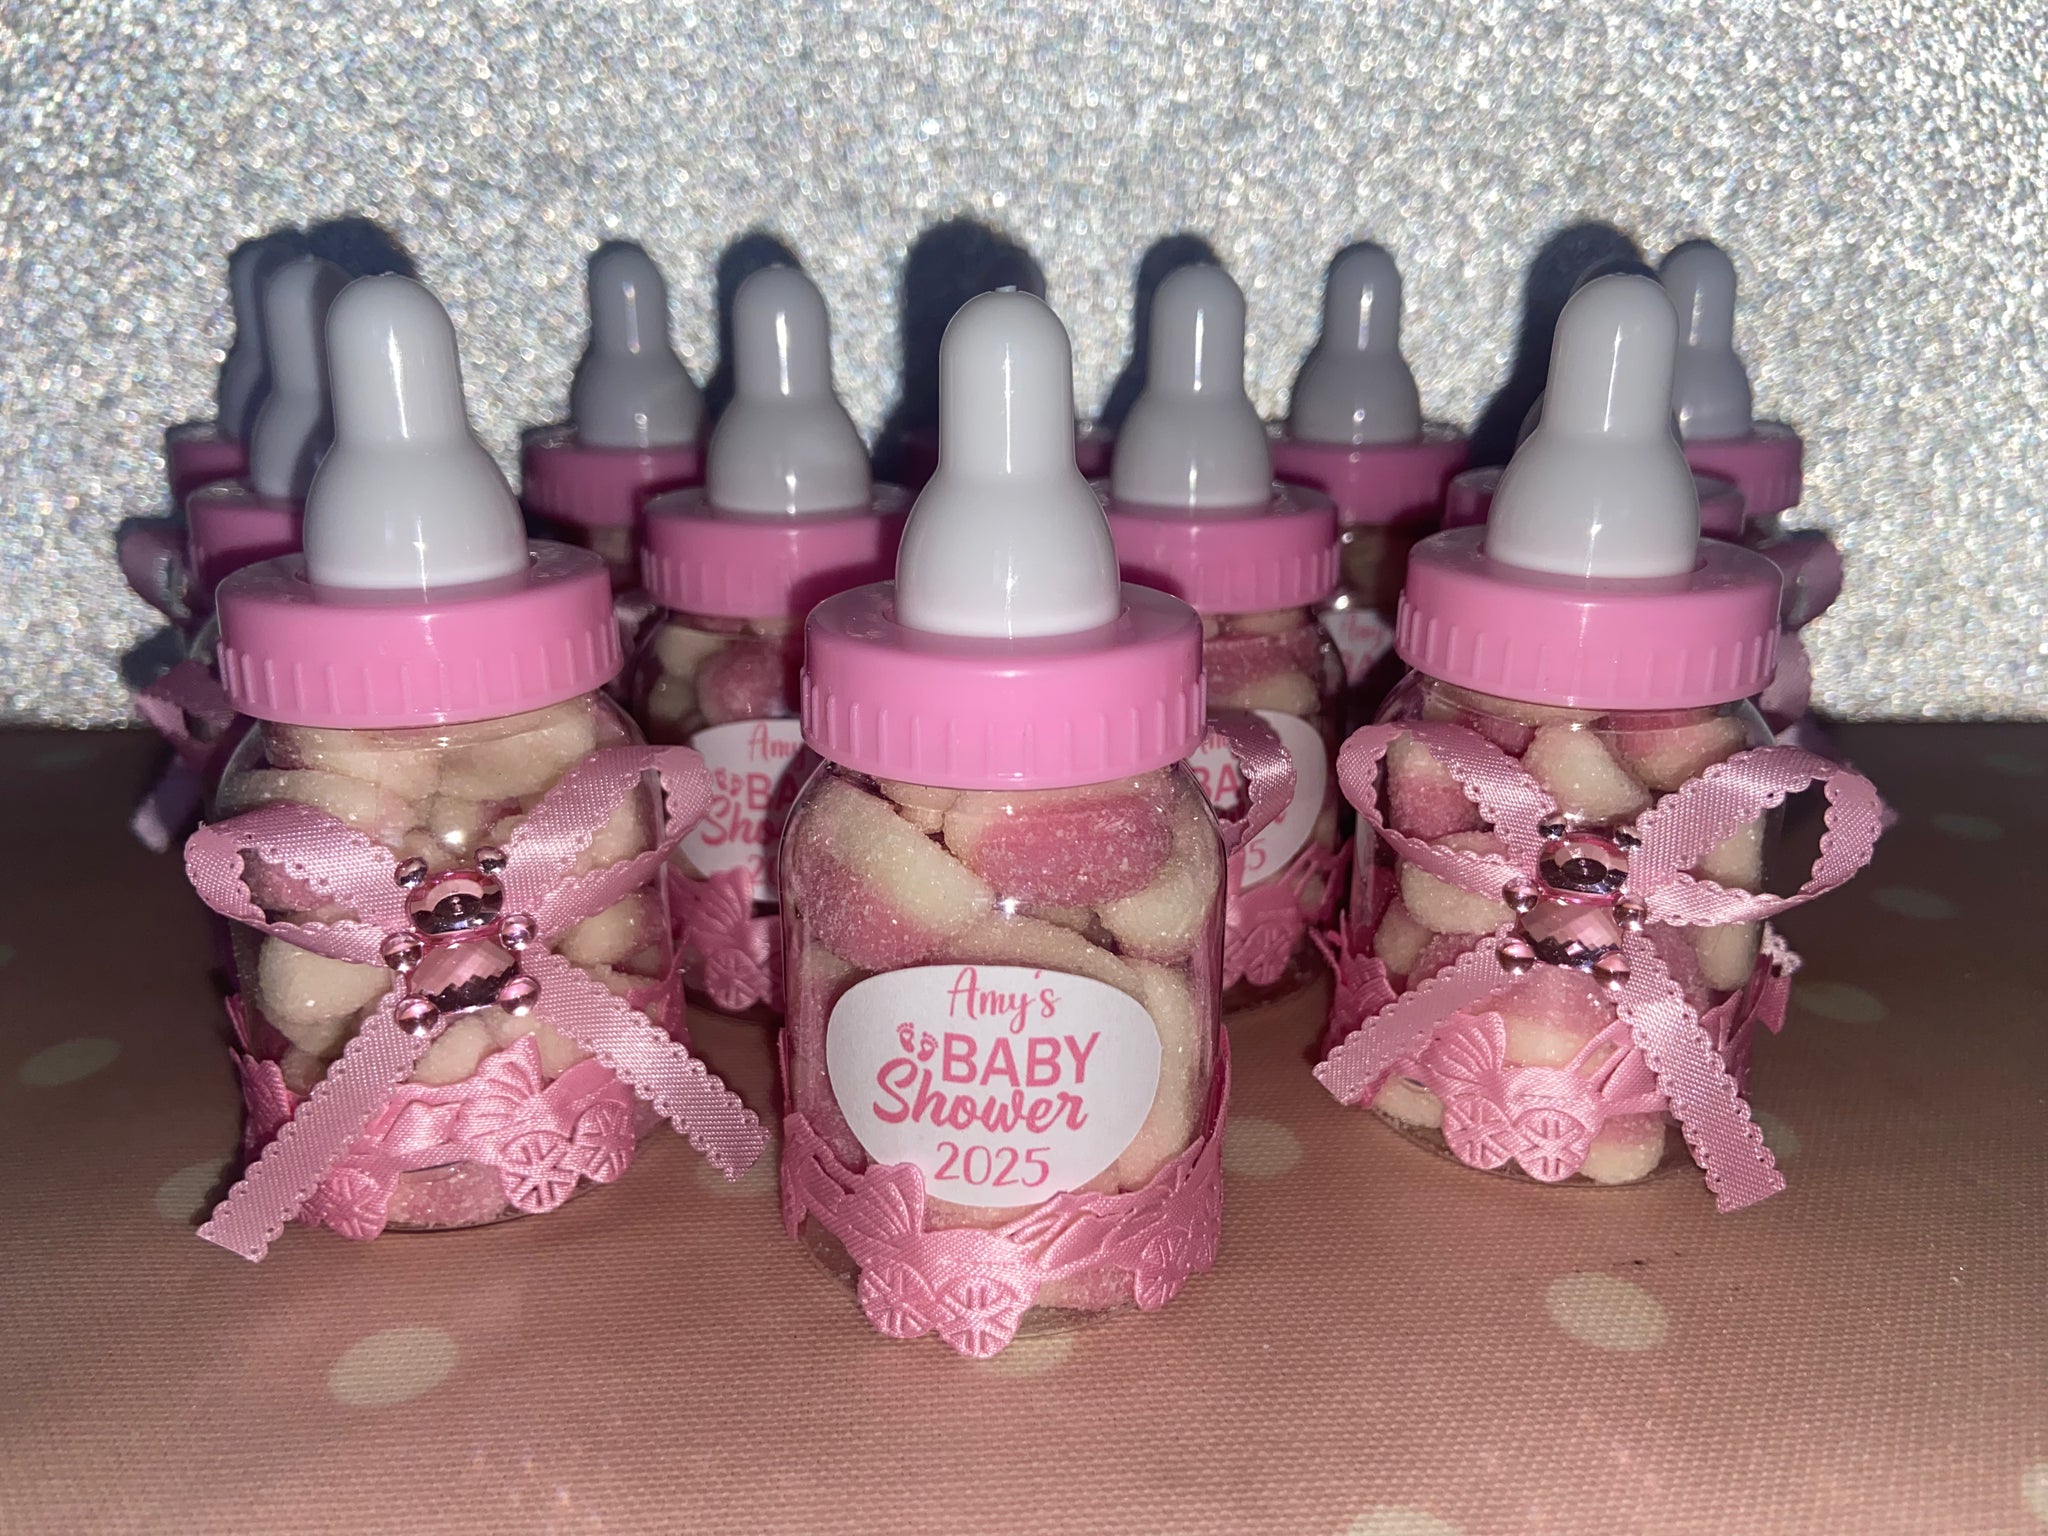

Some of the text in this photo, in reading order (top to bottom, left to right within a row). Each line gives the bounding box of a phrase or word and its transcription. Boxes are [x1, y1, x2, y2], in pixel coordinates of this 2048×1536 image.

[746, 772, 799, 810] BA
[701, 795, 780, 846] Sho
[947, 966, 1062, 1034] Amy's
[941, 1031, 1101, 1087] BABY
[872, 1057, 1088, 1134] Shower
[933, 1141, 1051, 1187] 2025
